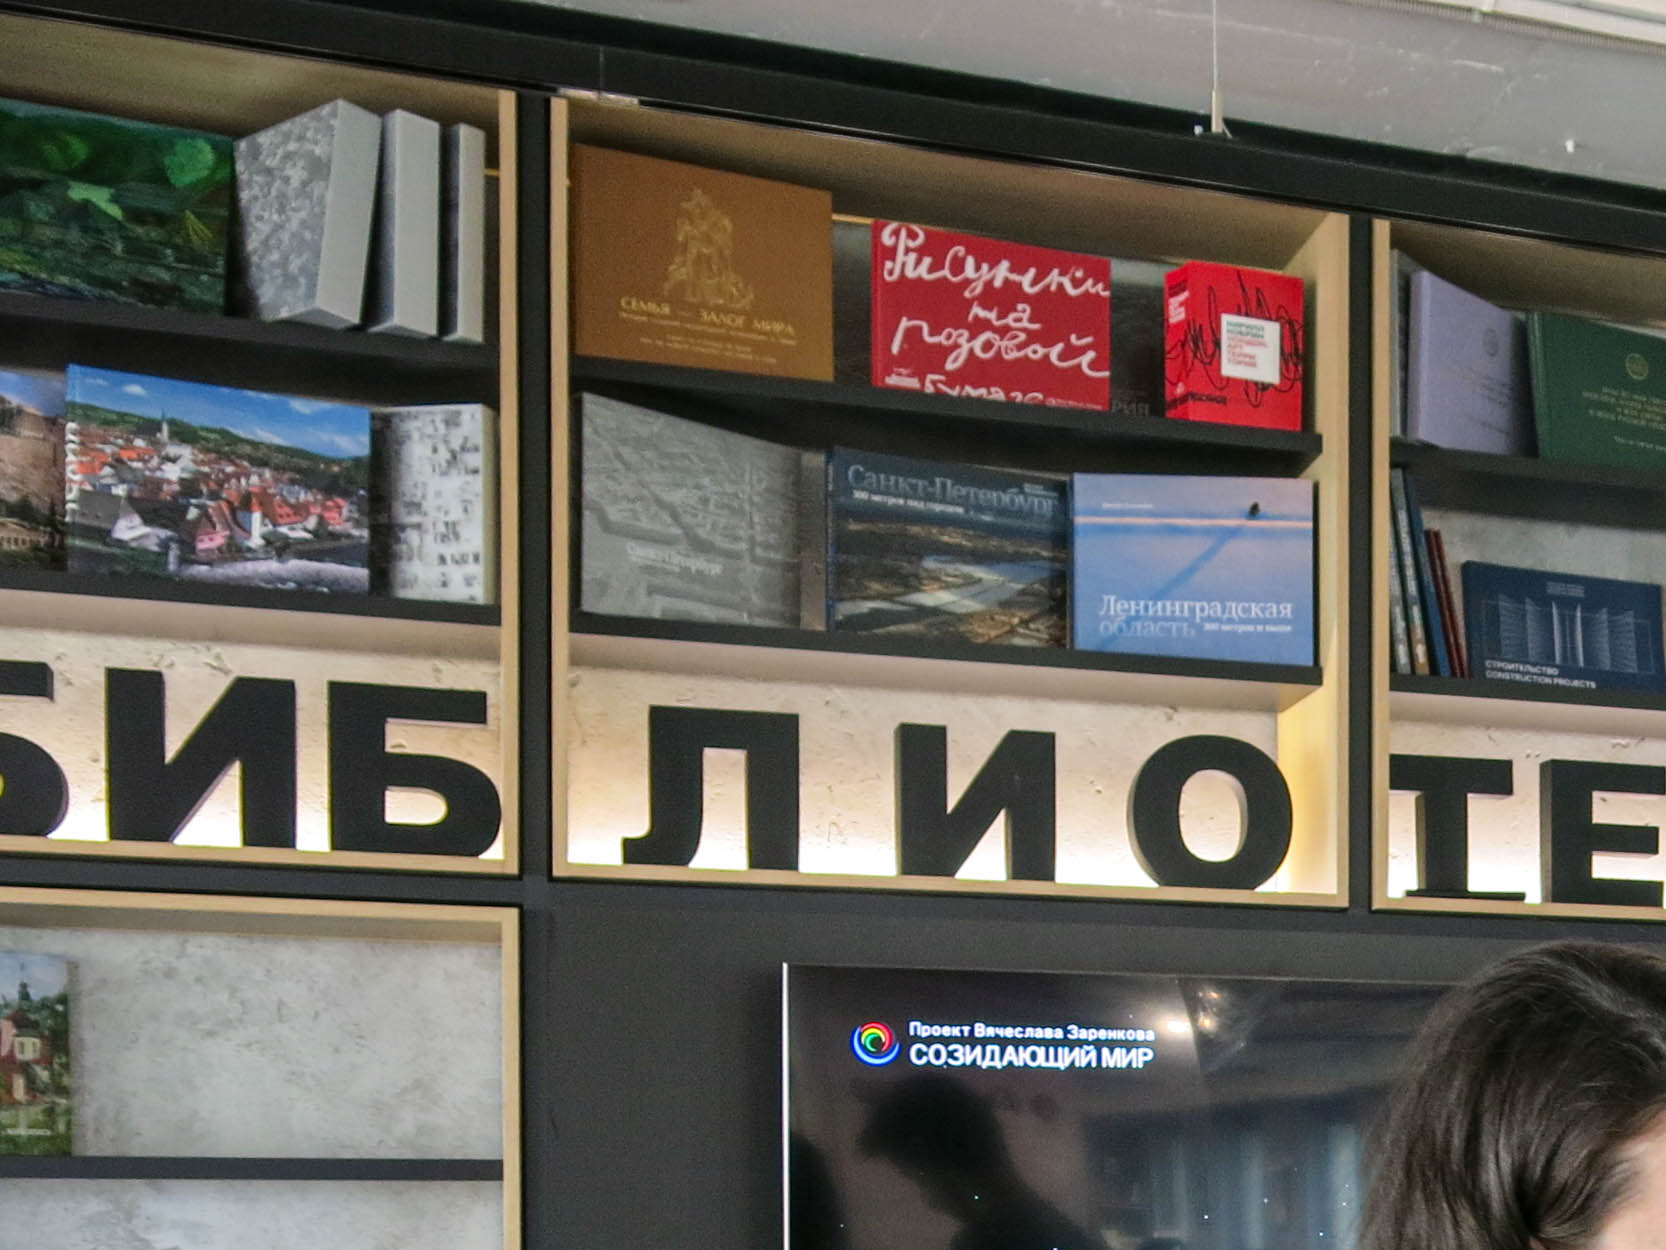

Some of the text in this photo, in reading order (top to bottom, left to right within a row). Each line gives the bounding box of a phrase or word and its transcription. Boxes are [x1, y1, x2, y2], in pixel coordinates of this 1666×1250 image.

[619, 296, 671, 315] СЕМЬЯ
[701, 309, 745, 328] ЗАЛОГ
[752, 319, 795, 336] МИРА
[968, 301, 1041, 328] на
[891, 317, 1110, 378] розовой
[847, 463, 1059, 518] Санкт-Петербург
[1100, 594, 1294, 624] Ленинградская
[1100, 615, 1196, 640] область
[1485, 659, 1560, 677] СТРОИТЕЛЬСТВО
[1485, 670, 1598, 690] CONSTRUCTION PROJECTS
[909, 1021, 1156, 1042] Проект Вячеслава Заренкова
[909, 1042, 1155, 1069] СОЗИДАЮЩИЙ МИР
